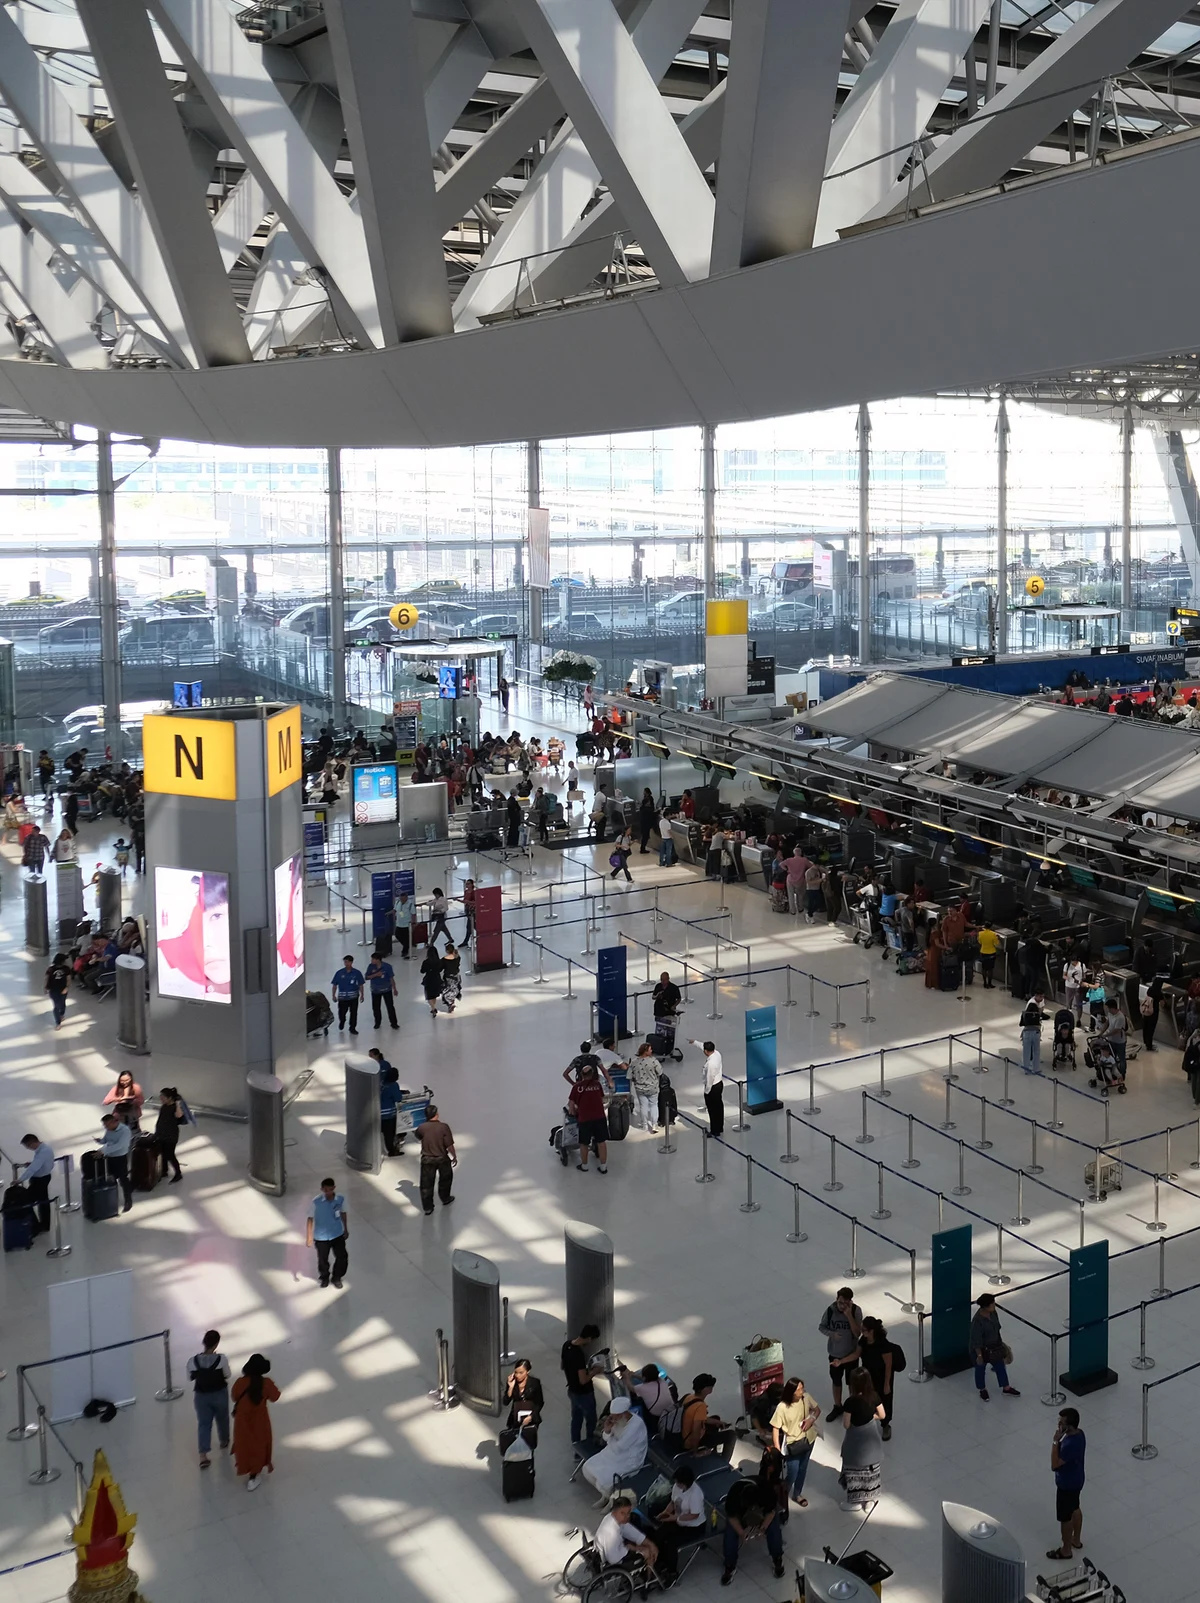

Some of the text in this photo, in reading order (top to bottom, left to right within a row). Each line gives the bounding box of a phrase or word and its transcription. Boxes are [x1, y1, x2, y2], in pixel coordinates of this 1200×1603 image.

[1031, 580, 1039, 594] 5
[398, 608, 410, 625] 6
[174, 734, 204, 781] N
[278, 726, 292, 774] M
[363, 766, 386, 774] Notice
